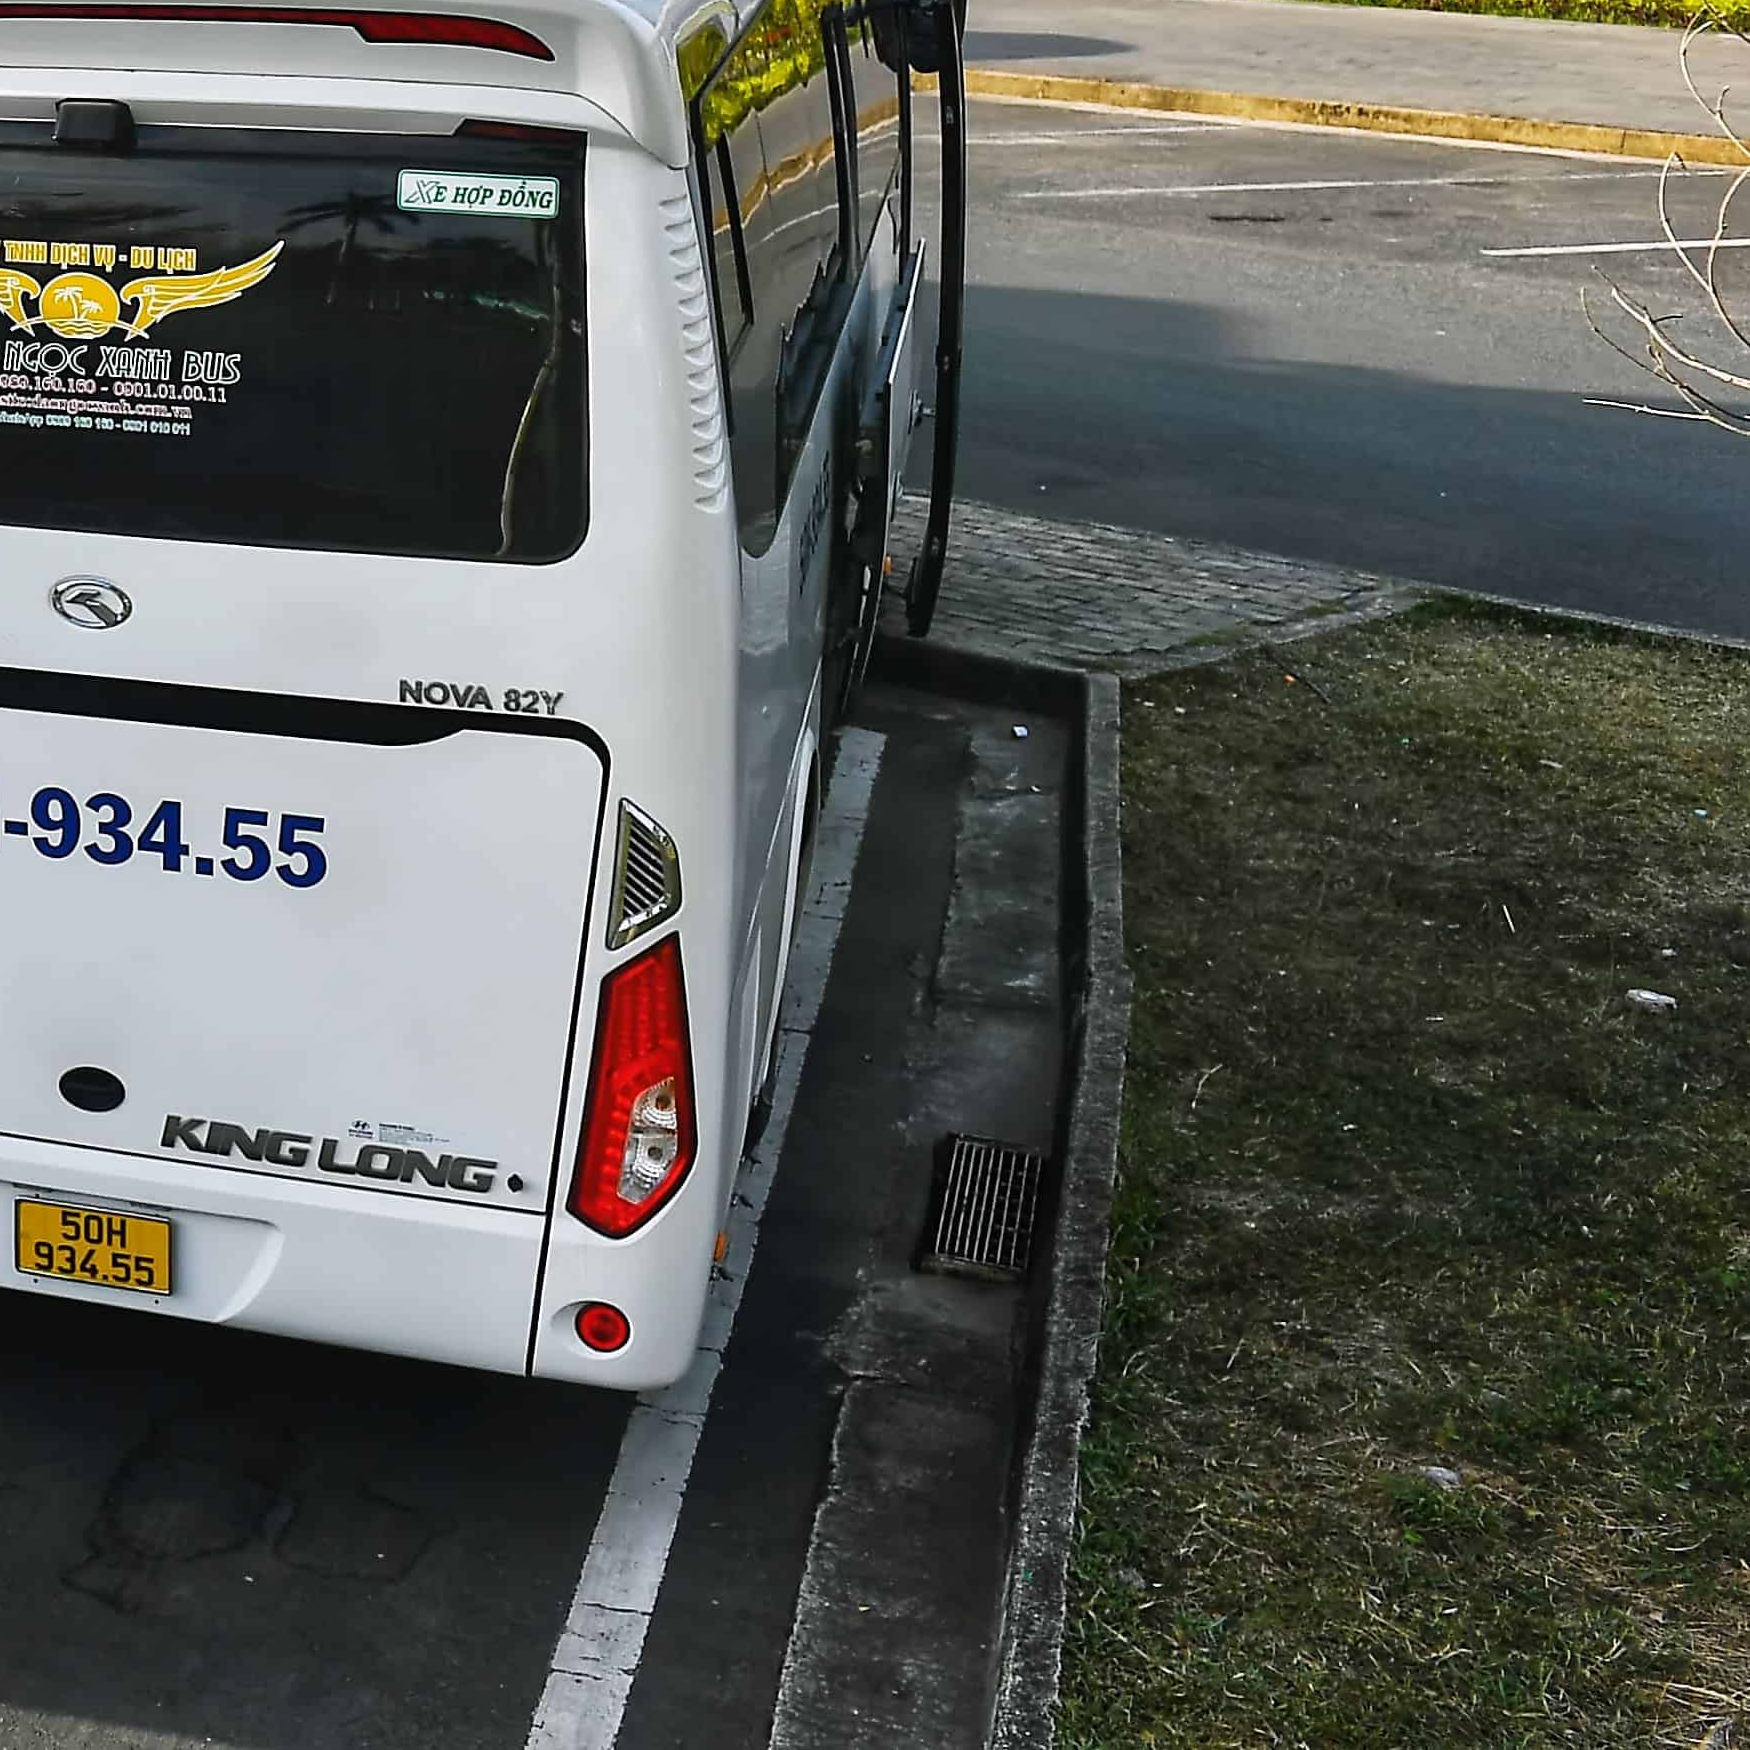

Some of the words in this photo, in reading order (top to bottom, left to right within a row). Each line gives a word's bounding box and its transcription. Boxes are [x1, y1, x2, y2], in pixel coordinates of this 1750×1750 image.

[404, 179, 448, 205] XE
[451, 184, 494, 209] HỢP
[497, 180, 554, 210] ĐỒNG
[3, 240, 47, 263] TNHH
[50, 242, 90, 270] DỊCH
[92, 243, 116, 272] VỤ
[130, 245, 155, 269] DU
[156, 246, 197, 274] LỊCH
[3, 340, 88, 379] NGỌC
[95, 345, 172, 381] XANH
[181, 351, 242, 385] BUS
[113, 381, 227, 403] 0901.01.00.11
[399, 679, 493, 710] NOVA
[502, 687, 565, 716] 82Y
[160, 1113, 312, 1168] KING
[317, 1137, 499, 1194] LONG
[60, 1209, 127, 1249] 50H
[34, 1240, 155, 1288] 934.55
